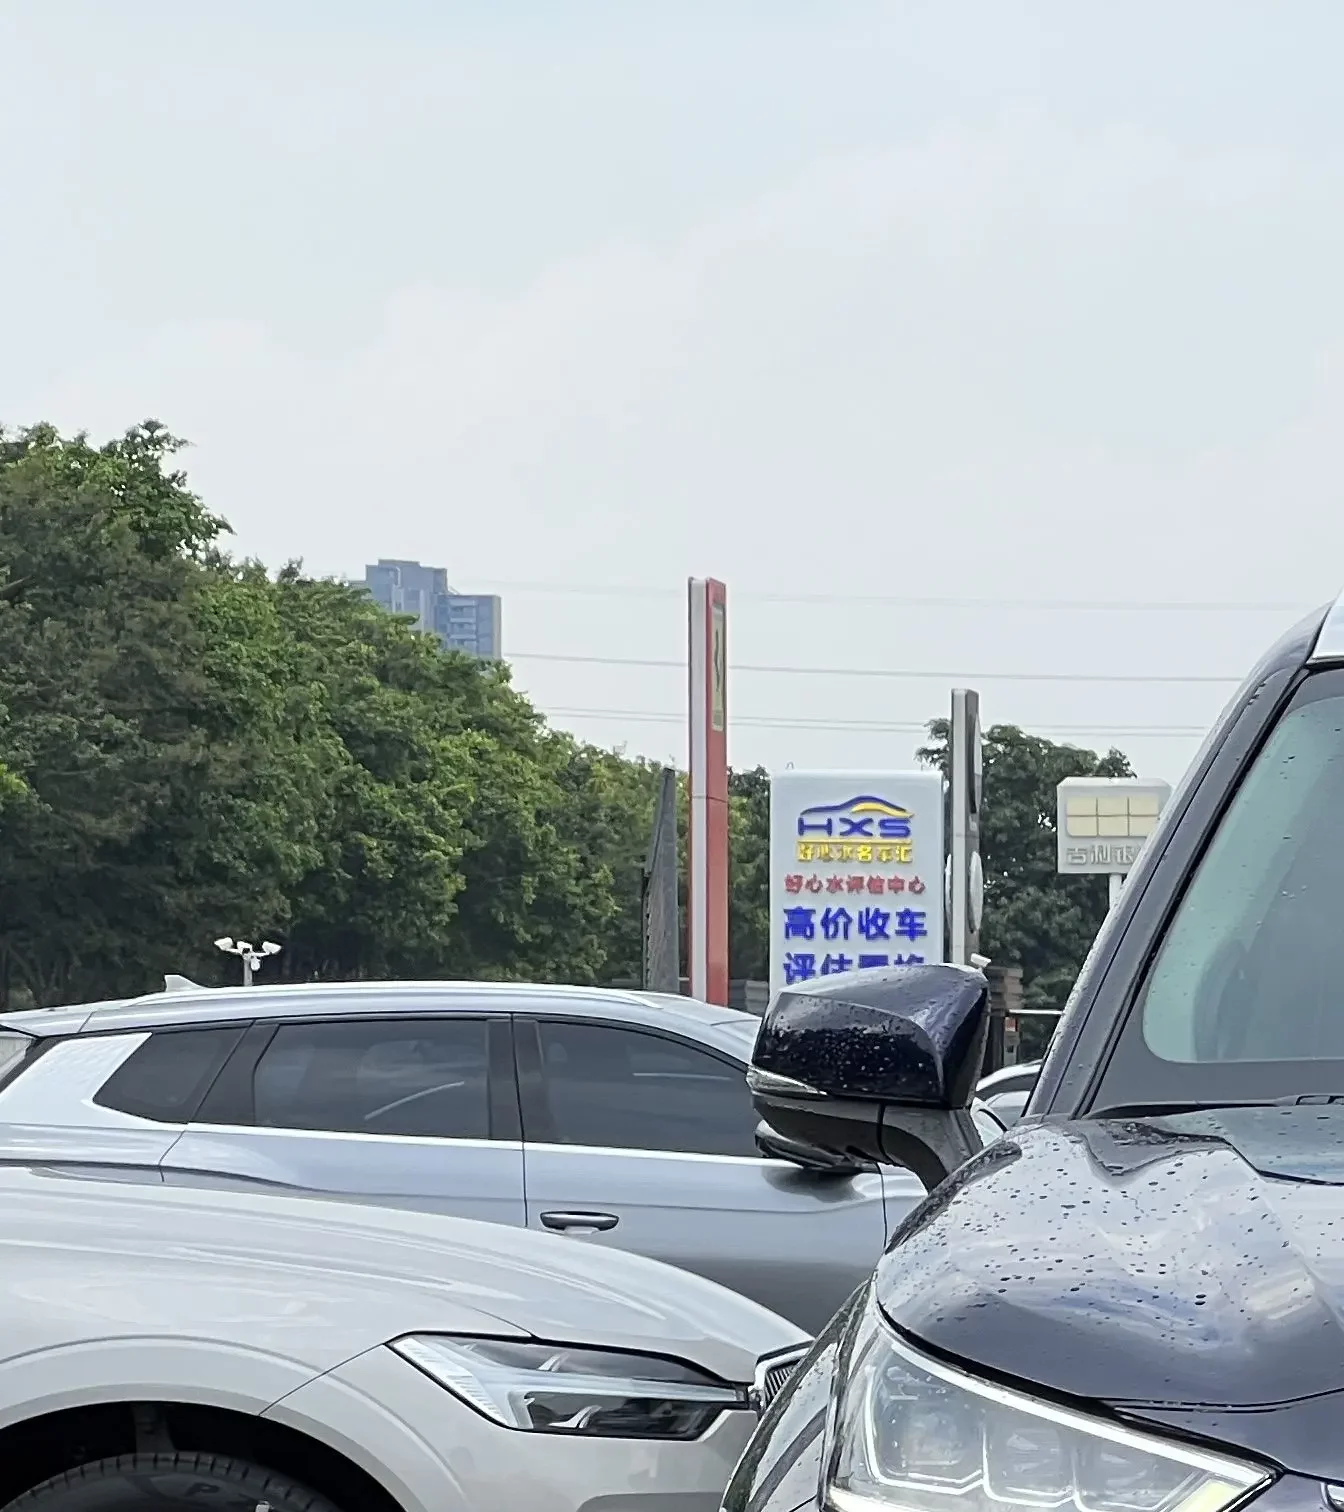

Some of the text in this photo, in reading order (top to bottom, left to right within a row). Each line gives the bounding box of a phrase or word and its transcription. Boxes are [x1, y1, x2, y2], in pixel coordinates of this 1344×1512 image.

[797, 817, 912, 838] HXS
[783, 906, 928, 942] 高价收车
